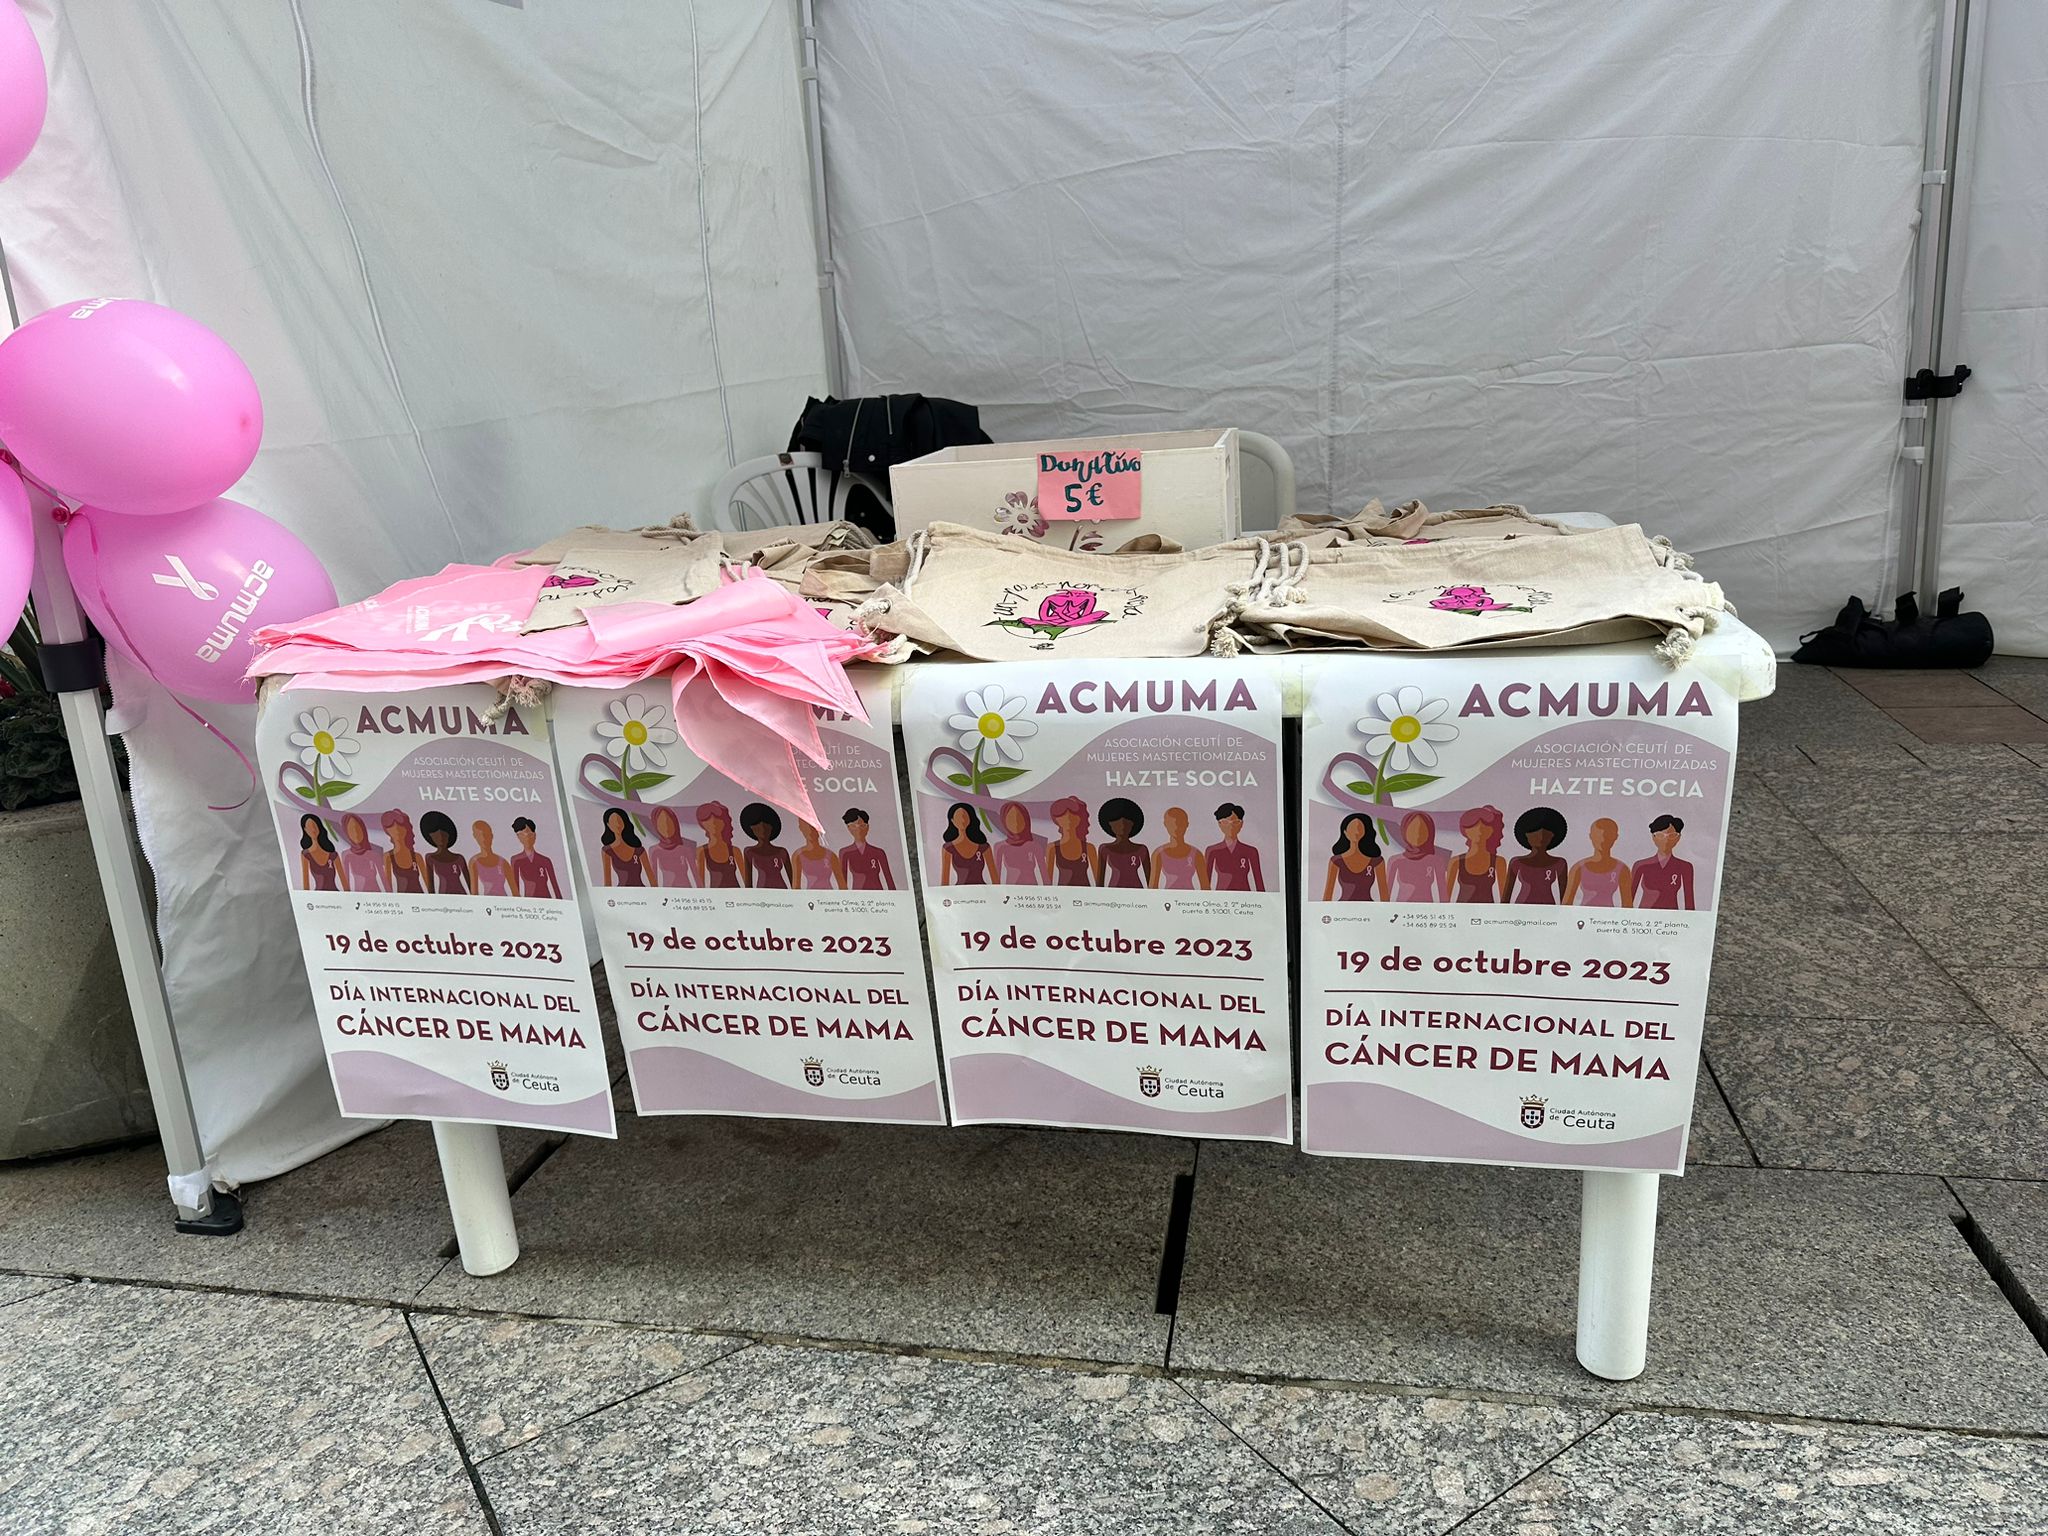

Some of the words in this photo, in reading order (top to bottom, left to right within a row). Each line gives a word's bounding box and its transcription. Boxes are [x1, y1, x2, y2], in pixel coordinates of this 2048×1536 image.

[194, 559, 275, 664] acmuma
[1036, 678, 1257, 714] ACMUMA
[1458, 681, 1713, 717] ACMUMA
[356, 705, 529, 735] ACMUMA
[1103, 735, 1181, 748] ASOCIACIÓN
[1184, 734, 1221, 747] CEUTÍ
[1226, 737, 1244, 747] DE
[1534, 740, 1623, 754] ASOCIACIÓN
[1625, 741, 1668, 754] CEUTÍ
[1674, 744, 1693, 755] DE
[846, 745, 861, 755] DE
[1087, 752, 1140, 762] MUJERES
[1142, 751, 1266, 762] MASTECTIOMIZADAS
[413, 754, 475, 766] ASOCIACIÓN
[510, 757, 524, 767] DE
[1511, 758, 1572, 769] MUJERES
[1575, 757, 1717, 771] MASTECTIOMIZADAS
[401, 769, 444, 779] MUJERES
[1105, 770, 1180, 787] HAZTE
[1185, 770, 1259, 787] SOCIA
[813, 777, 878, 793] SOCIA
[1529, 777, 1614, 795] HAZTE
[1621, 777, 1704, 798] SOCIA
[418, 786, 480, 801] HAZTE
[483, 787, 542, 803] SOCIA
[1483, 918, 1557, 927] acmuma@gmail.com
[1589, 918, 1619, 926] Teniente
[1655, 928, 1678, 936] Ceuta
[325, 933, 351, 954] 19
[358, 930, 388, 953] de
[395, 932, 494, 957] octubre
[500, 940, 563, 964] 2023
[627, 931, 654, 951] 19
[663, 928, 696, 951] de
[704, 928, 814, 953] octubre
[821, 935, 892, 957] 2023
[961, 931, 991, 952] 19
[1000, 926, 1037, 949] de
[1046, 929, 1166, 955] octubre
[1175, 937, 1253, 962] 2023
[1336, 950, 1370, 973] 19
[1380, 946, 1423, 972] de
[1433, 949, 1571, 978] octubre
[1582, 958, 1671, 985] 2023
[329, 980, 364, 1001] DÍA
[370, 986, 539, 1011] INTERNACIONAL
[543, 994, 581, 1013] DEL
[630, 977, 670, 999] DÍA
[675, 982, 861, 1005] INTERNACIONAL
[867, 989, 910, 1005] DEL
[957, 979, 999, 1002] DÍA
[1006, 984, 1212, 1011] INTERNACIONAL
[1220, 994, 1266, 1014] DEL
[336, 1008, 450, 1039] CÁNCER
[456, 1019, 494, 1041] DE
[500, 1021, 587, 1049] MAMA
[637, 1004, 761, 1036] CÁNCER
[768, 1015, 809, 1038] DE
[816, 1018, 915, 1042] MAMA
[961, 1007, 1097, 1042] CÁNCER
[1106, 1020, 1149, 1045] DE
[1159, 1024, 1268, 1052] MAMA
[1325, 1003, 1371, 1027] DÍA
[1380, 1008, 1615, 1038] INTERNACIONAL
[1624, 1020, 1676, 1041] DEL
[1324, 1034, 1478, 1070] CÁNCER
[1489, 1047, 1539, 1073] DE
[1550, 1050, 1671, 1081] MAMA
[510, 1071, 528, 1079] Ciudad
[838, 1073, 881, 1087] Ceuta
[1164, 1077, 1188, 1085] Ciudad
[1189, 1079, 1224, 1088] Autónoma
[522, 1079, 560, 1092] Ceuta
[1177, 1084, 1225, 1099] Ceuta
[1549, 1107, 1576, 1115] Ciudad
[1577, 1109, 1617, 1118] Autónoma
[1562, 1115, 1616, 1131] Ceuta
